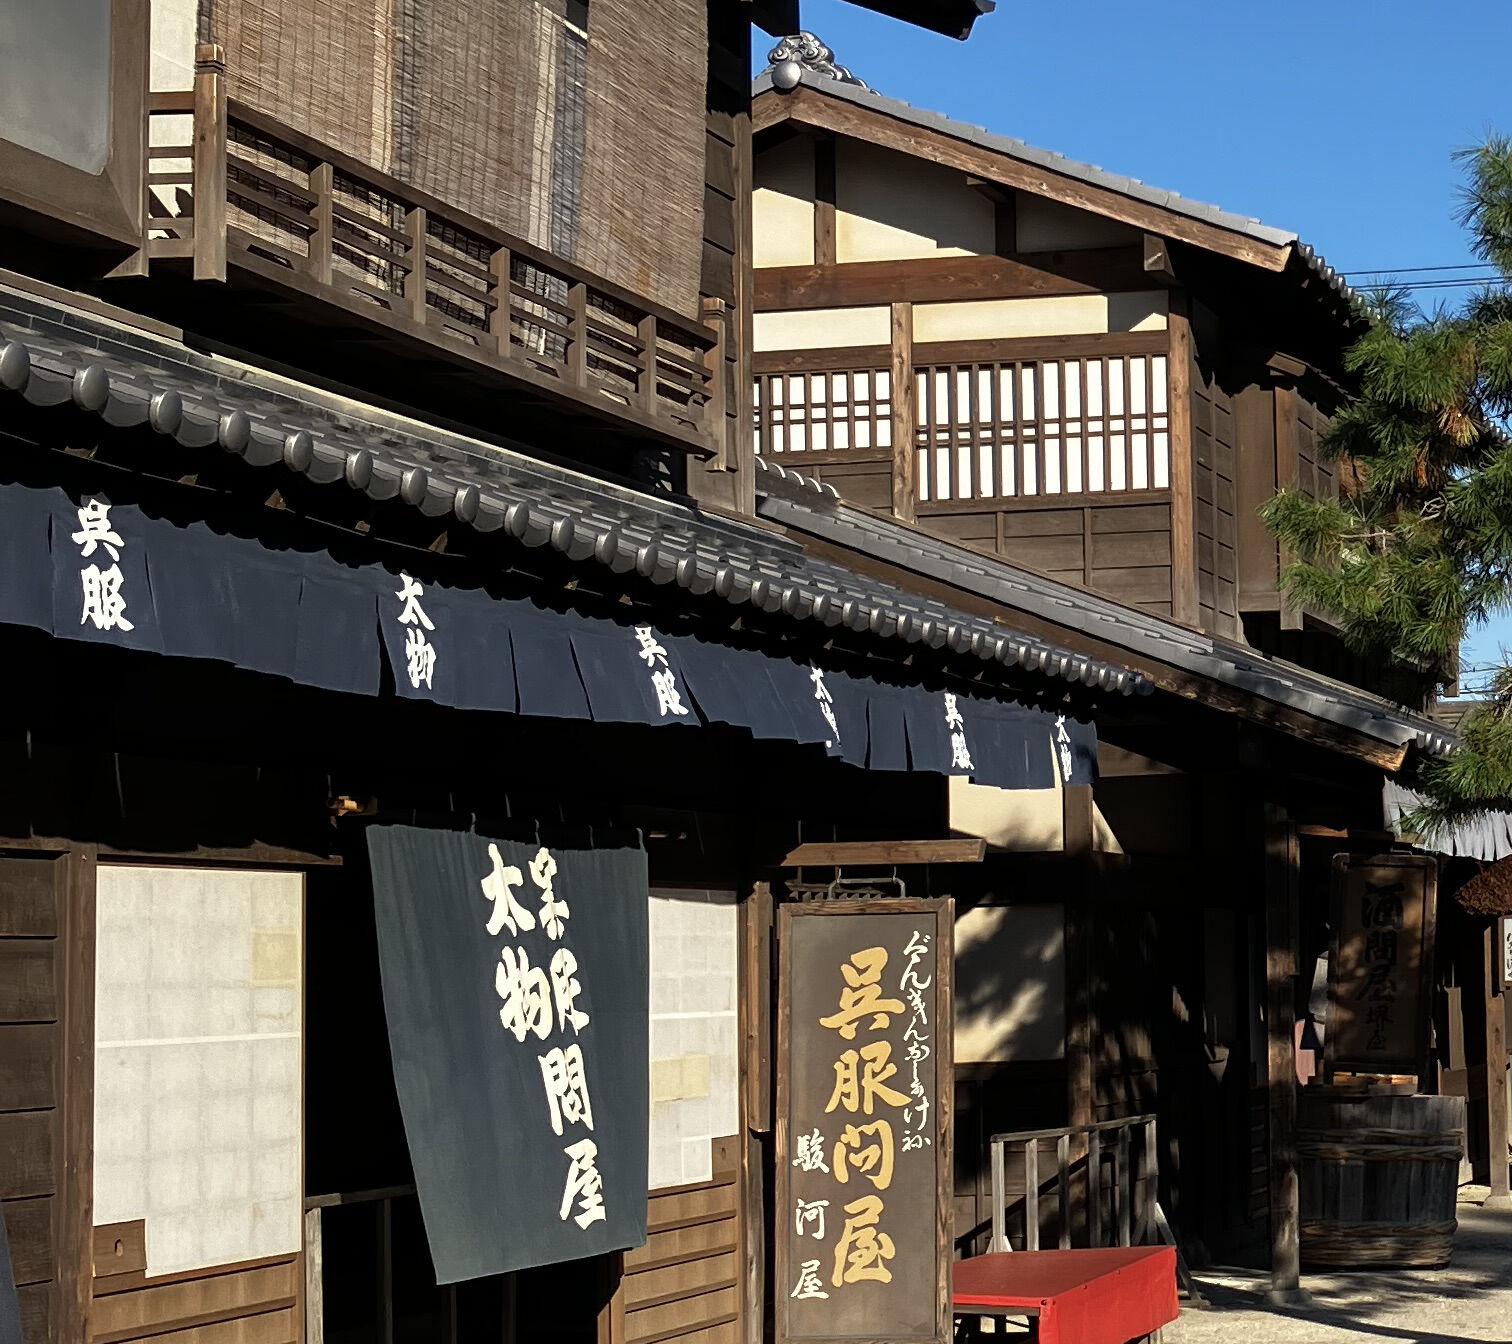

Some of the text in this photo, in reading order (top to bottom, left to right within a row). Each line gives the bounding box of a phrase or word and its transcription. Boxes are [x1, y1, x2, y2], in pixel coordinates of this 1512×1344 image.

[72, 499, 134, 632] 呉服
[395, 573, 436, 690] 太物
[635, 626, 688, 717] 呉服
[480, 842, 553, 1043] 太物
[819, 947, 913, 1288] 呉服問屋
[790, 1127, 831, 1300] 駿河屋
